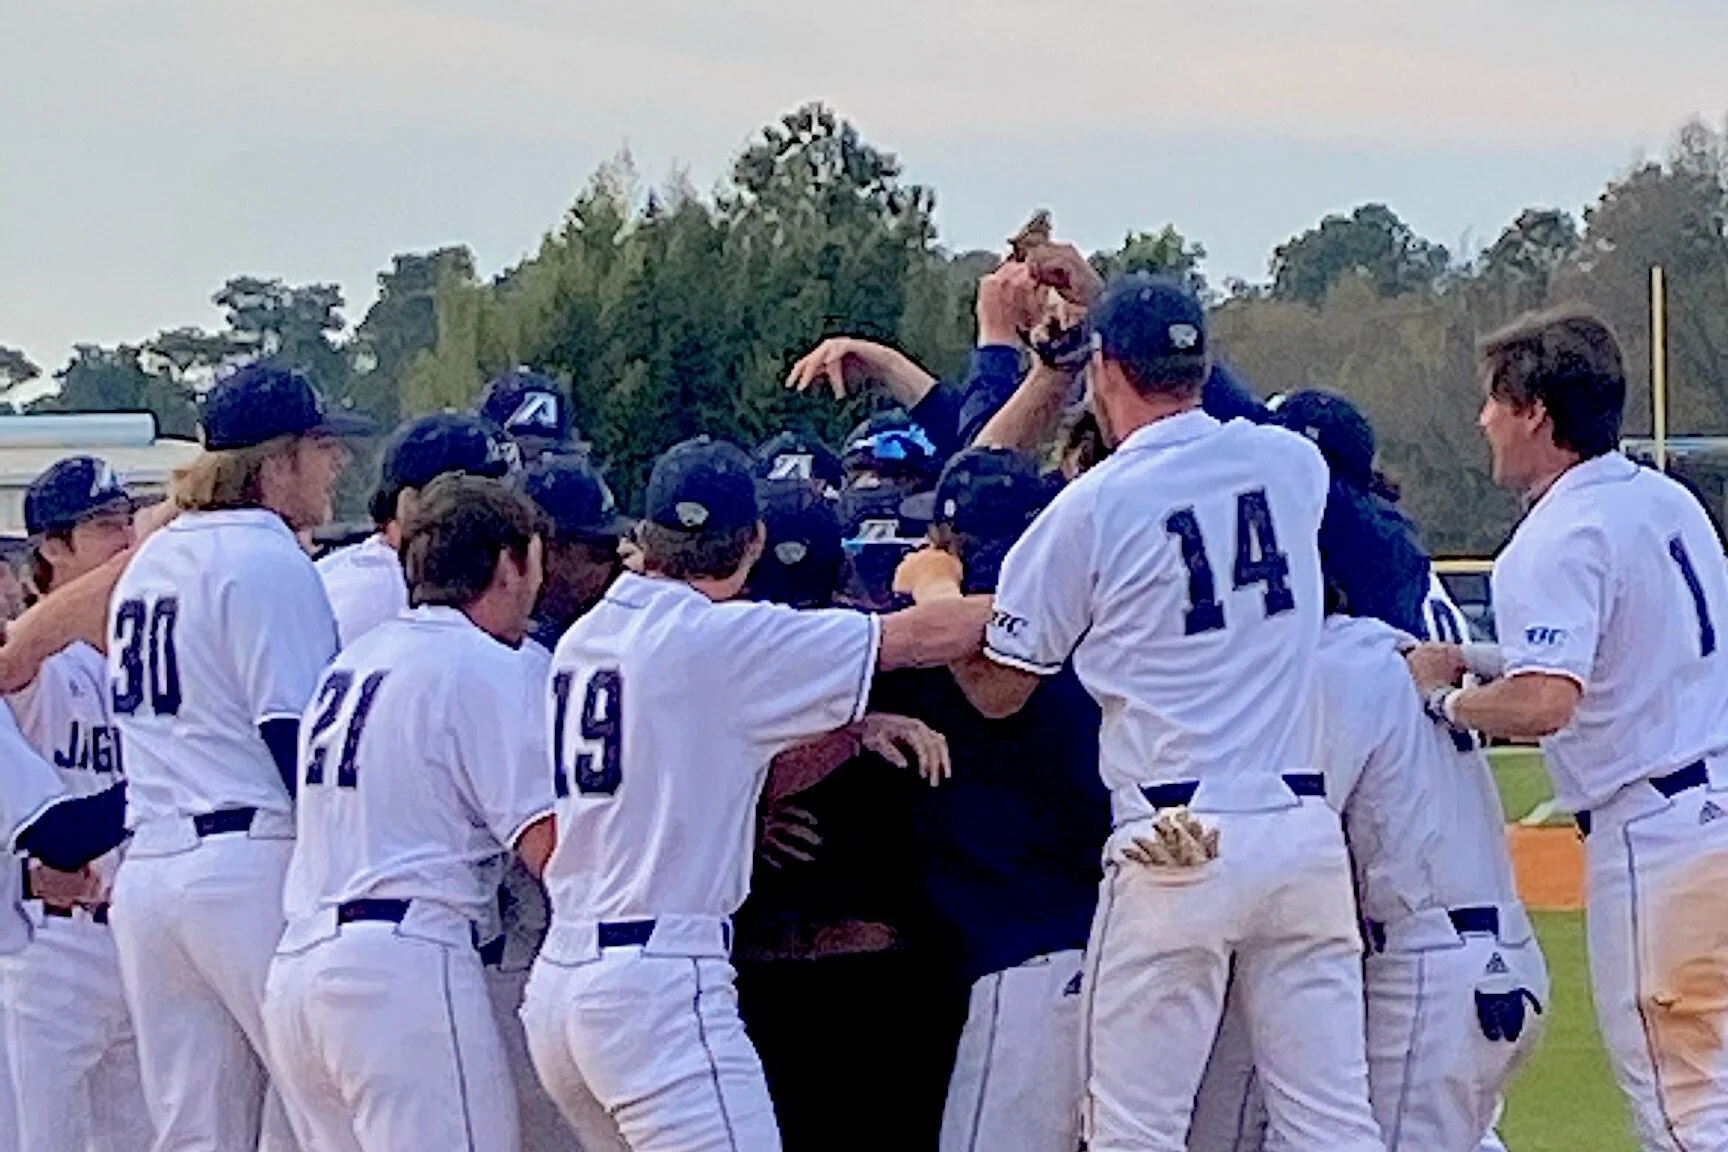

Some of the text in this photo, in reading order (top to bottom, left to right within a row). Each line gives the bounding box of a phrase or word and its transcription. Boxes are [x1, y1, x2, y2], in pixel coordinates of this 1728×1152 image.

[1166, 487, 1296, 636] 14
[1668, 535, 1716, 658] 1
[112, 598, 182, 716] 30
[305, 668, 391, 789] 21
[553, 668, 623, 798] 19
